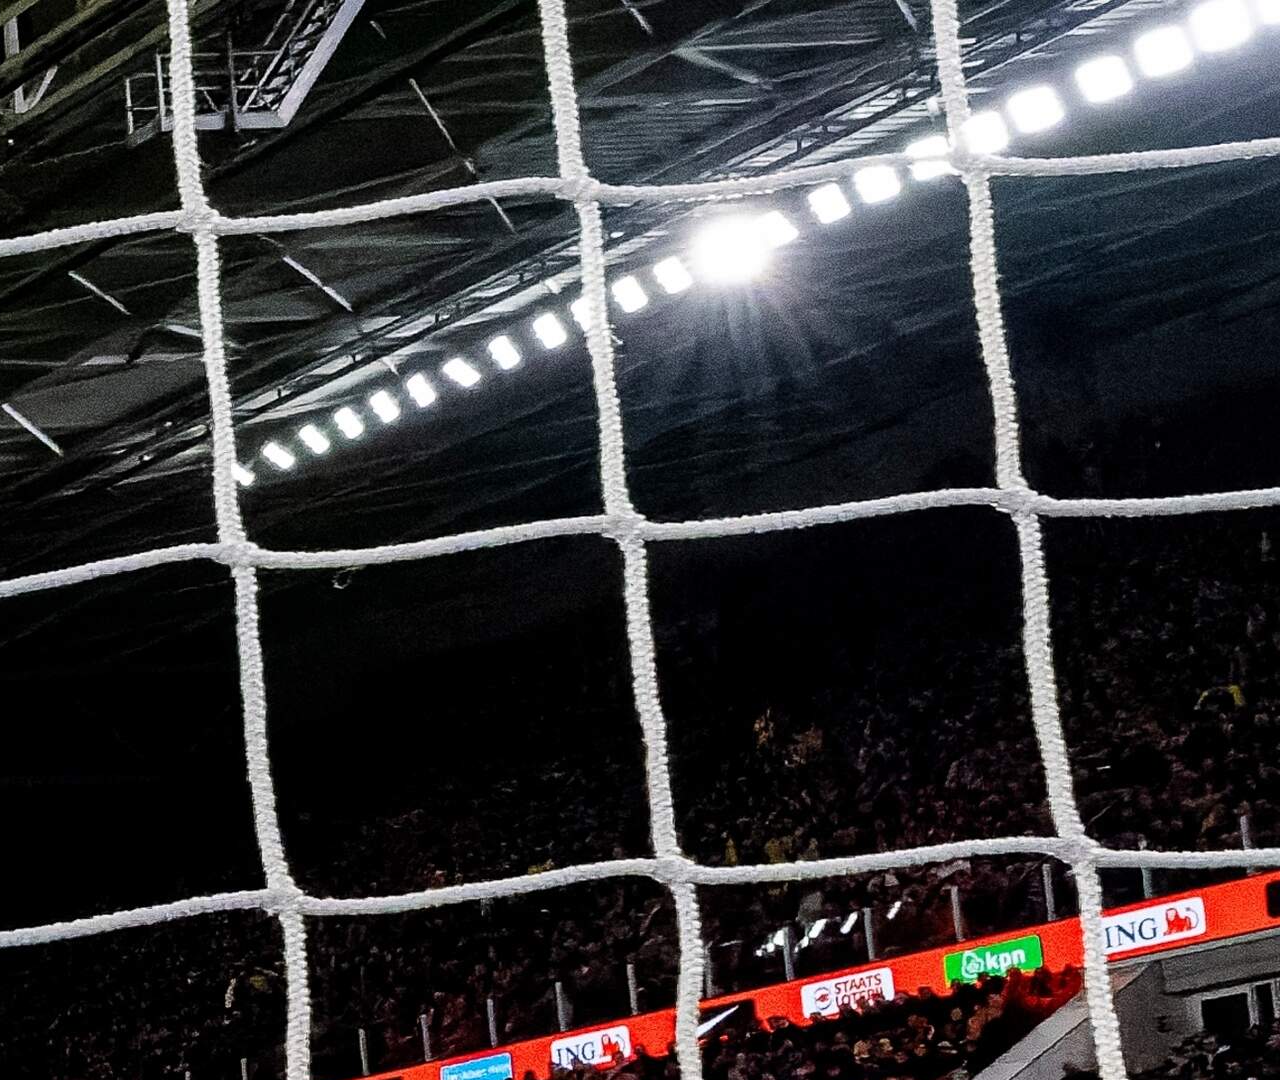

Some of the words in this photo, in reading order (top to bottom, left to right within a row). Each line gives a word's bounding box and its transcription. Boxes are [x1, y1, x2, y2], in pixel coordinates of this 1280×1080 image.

[1105, 917, 1158, 949] ING
[985, 949, 1026, 974] kpn
[834, 973, 882, 995] STAATS
[556, 1041, 595, 1067] ING
